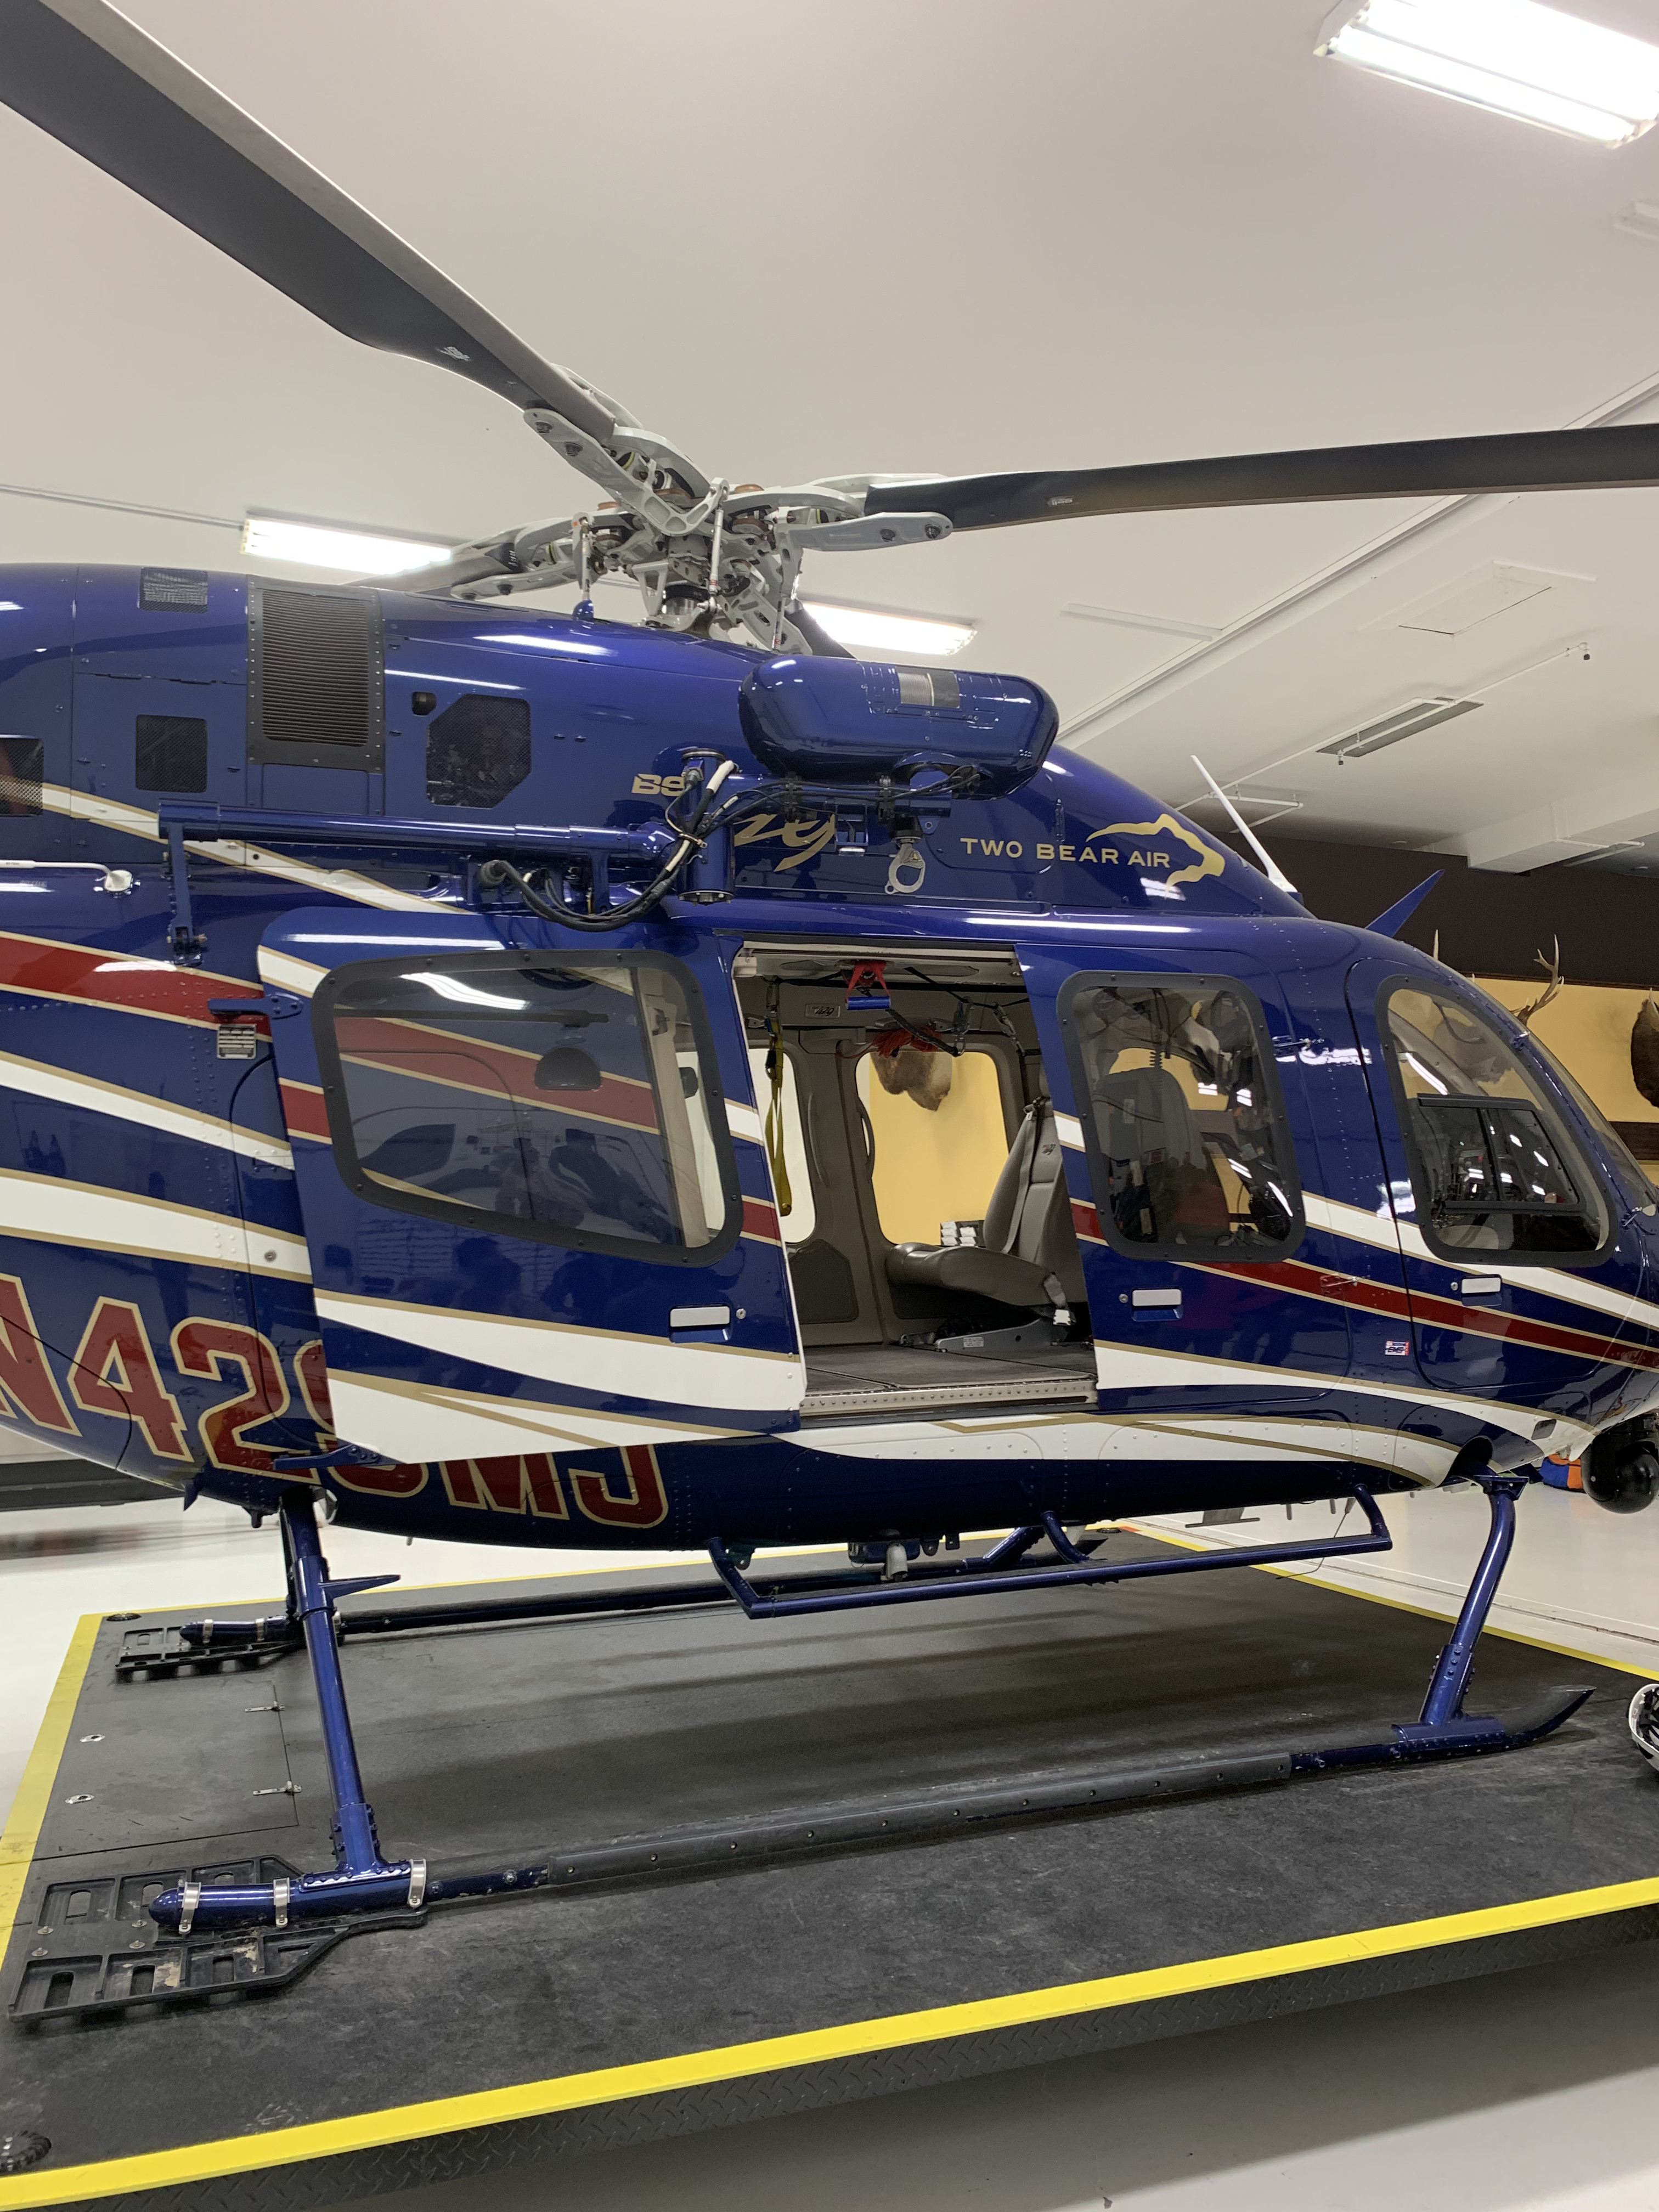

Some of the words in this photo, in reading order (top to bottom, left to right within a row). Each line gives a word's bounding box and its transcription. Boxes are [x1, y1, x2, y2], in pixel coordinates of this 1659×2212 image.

[960, 837, 1023, 858] TWO
[1036, 843, 1119, 865] BEAR
[1127, 849, 1171, 868] AIR
